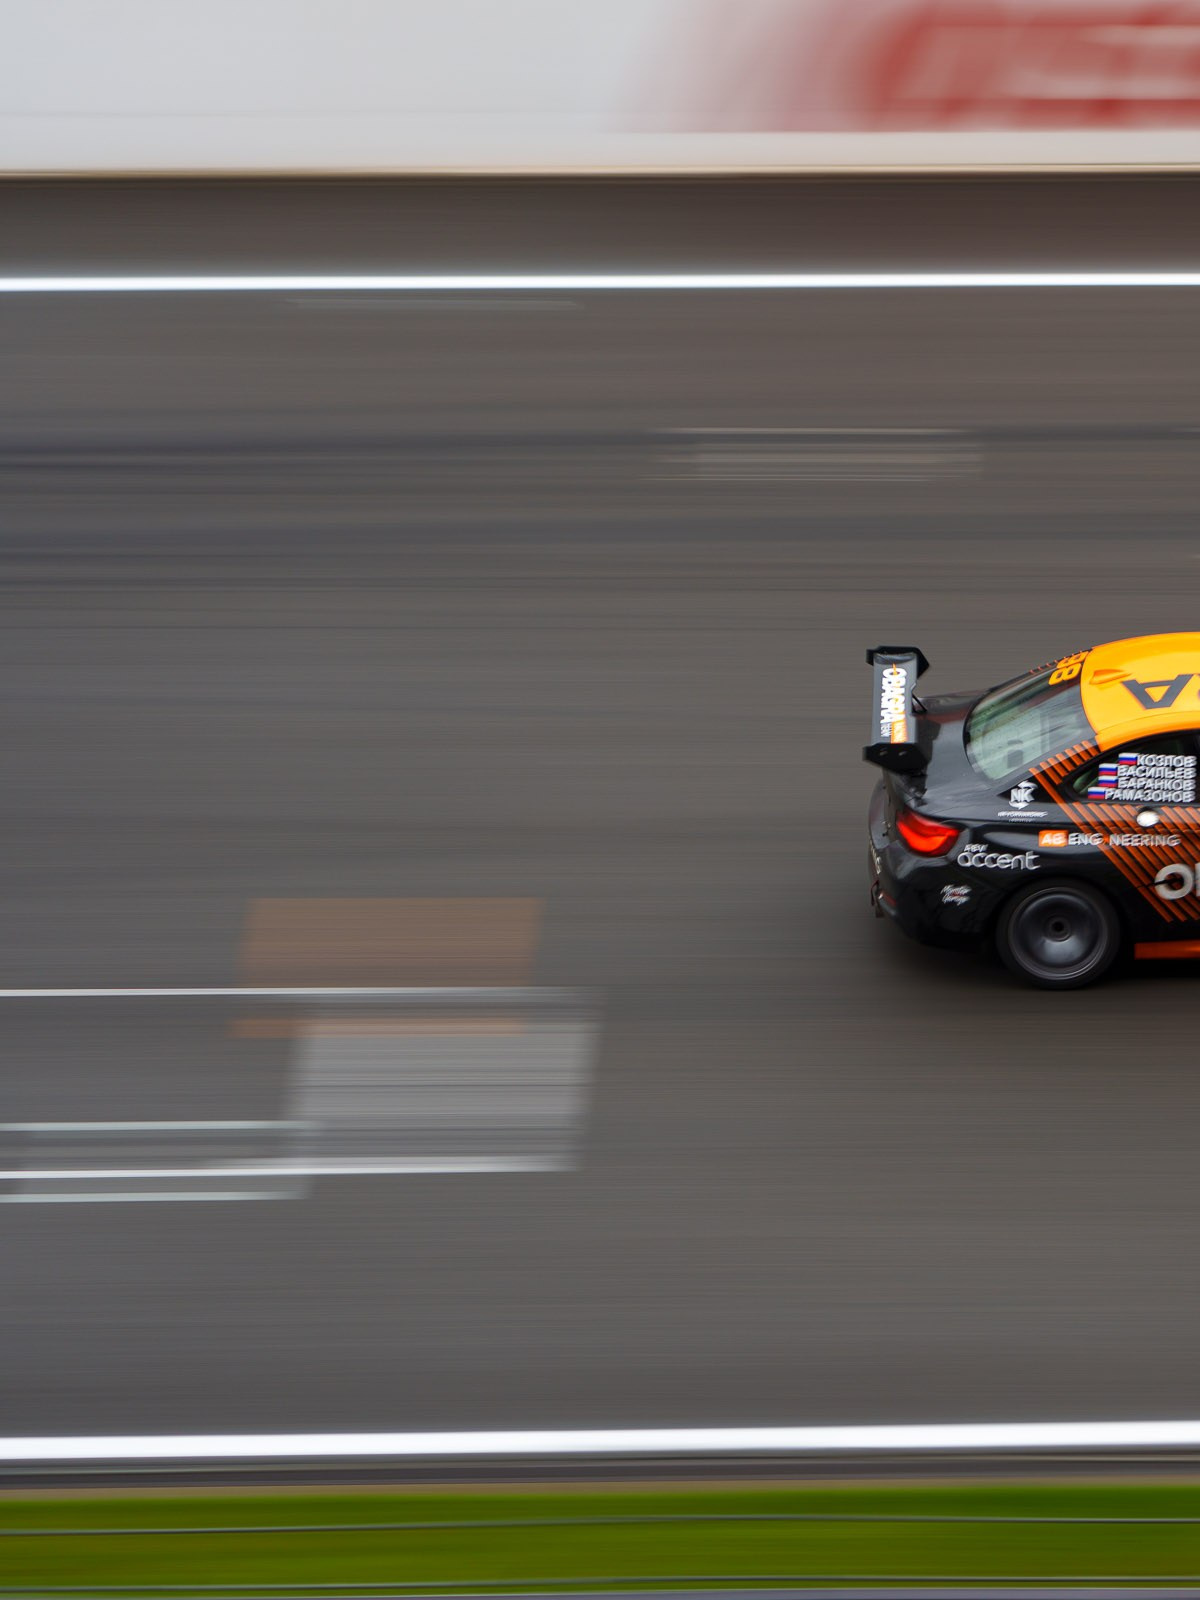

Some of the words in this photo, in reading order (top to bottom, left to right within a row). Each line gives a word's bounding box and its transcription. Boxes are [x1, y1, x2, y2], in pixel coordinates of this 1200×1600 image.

[880, 668, 907, 723] OBAGRA
[1137, 754, 1197, 768] КОЗЛОВ
[1117, 764, 1197, 780] ВАСИЛЬЕВ
[1117, 776, 1197, 791] БАРАНКОВ
[1010, 787, 1035, 802] NK
[1104, 787, 1196, 803] РАМАЗОНОВ
[958, 850, 1041, 870] accent
